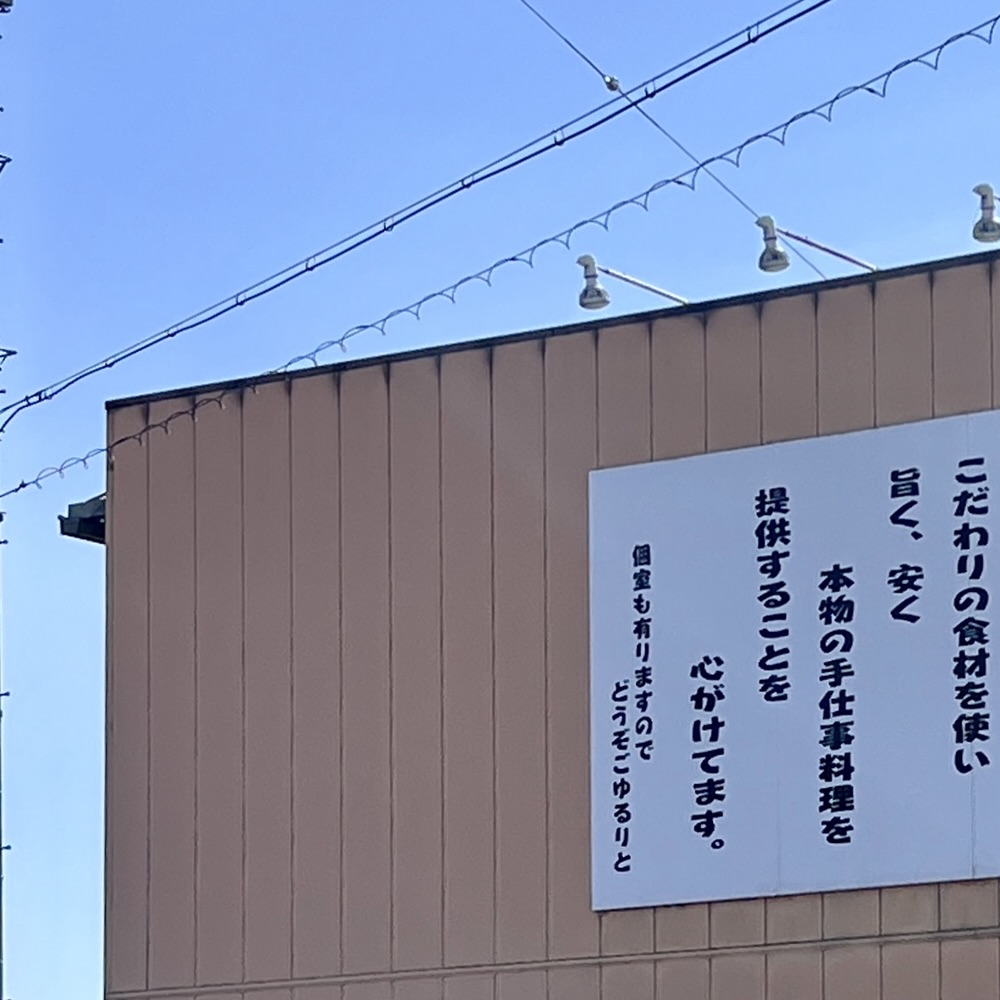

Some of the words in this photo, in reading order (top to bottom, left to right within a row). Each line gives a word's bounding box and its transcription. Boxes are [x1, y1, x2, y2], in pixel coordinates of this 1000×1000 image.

[633, 544, 653, 760] 個室も有りますので
[755, 487, 791, 701] 提供することを
[953, 458, 990, 773] こだわりの食材を使い
[612, 680, 631, 872] どうぞごゆるりと
[690, 656, 725, 849] 心がけてます。
[818, 564, 855, 844] 本物の手仕事料理を
